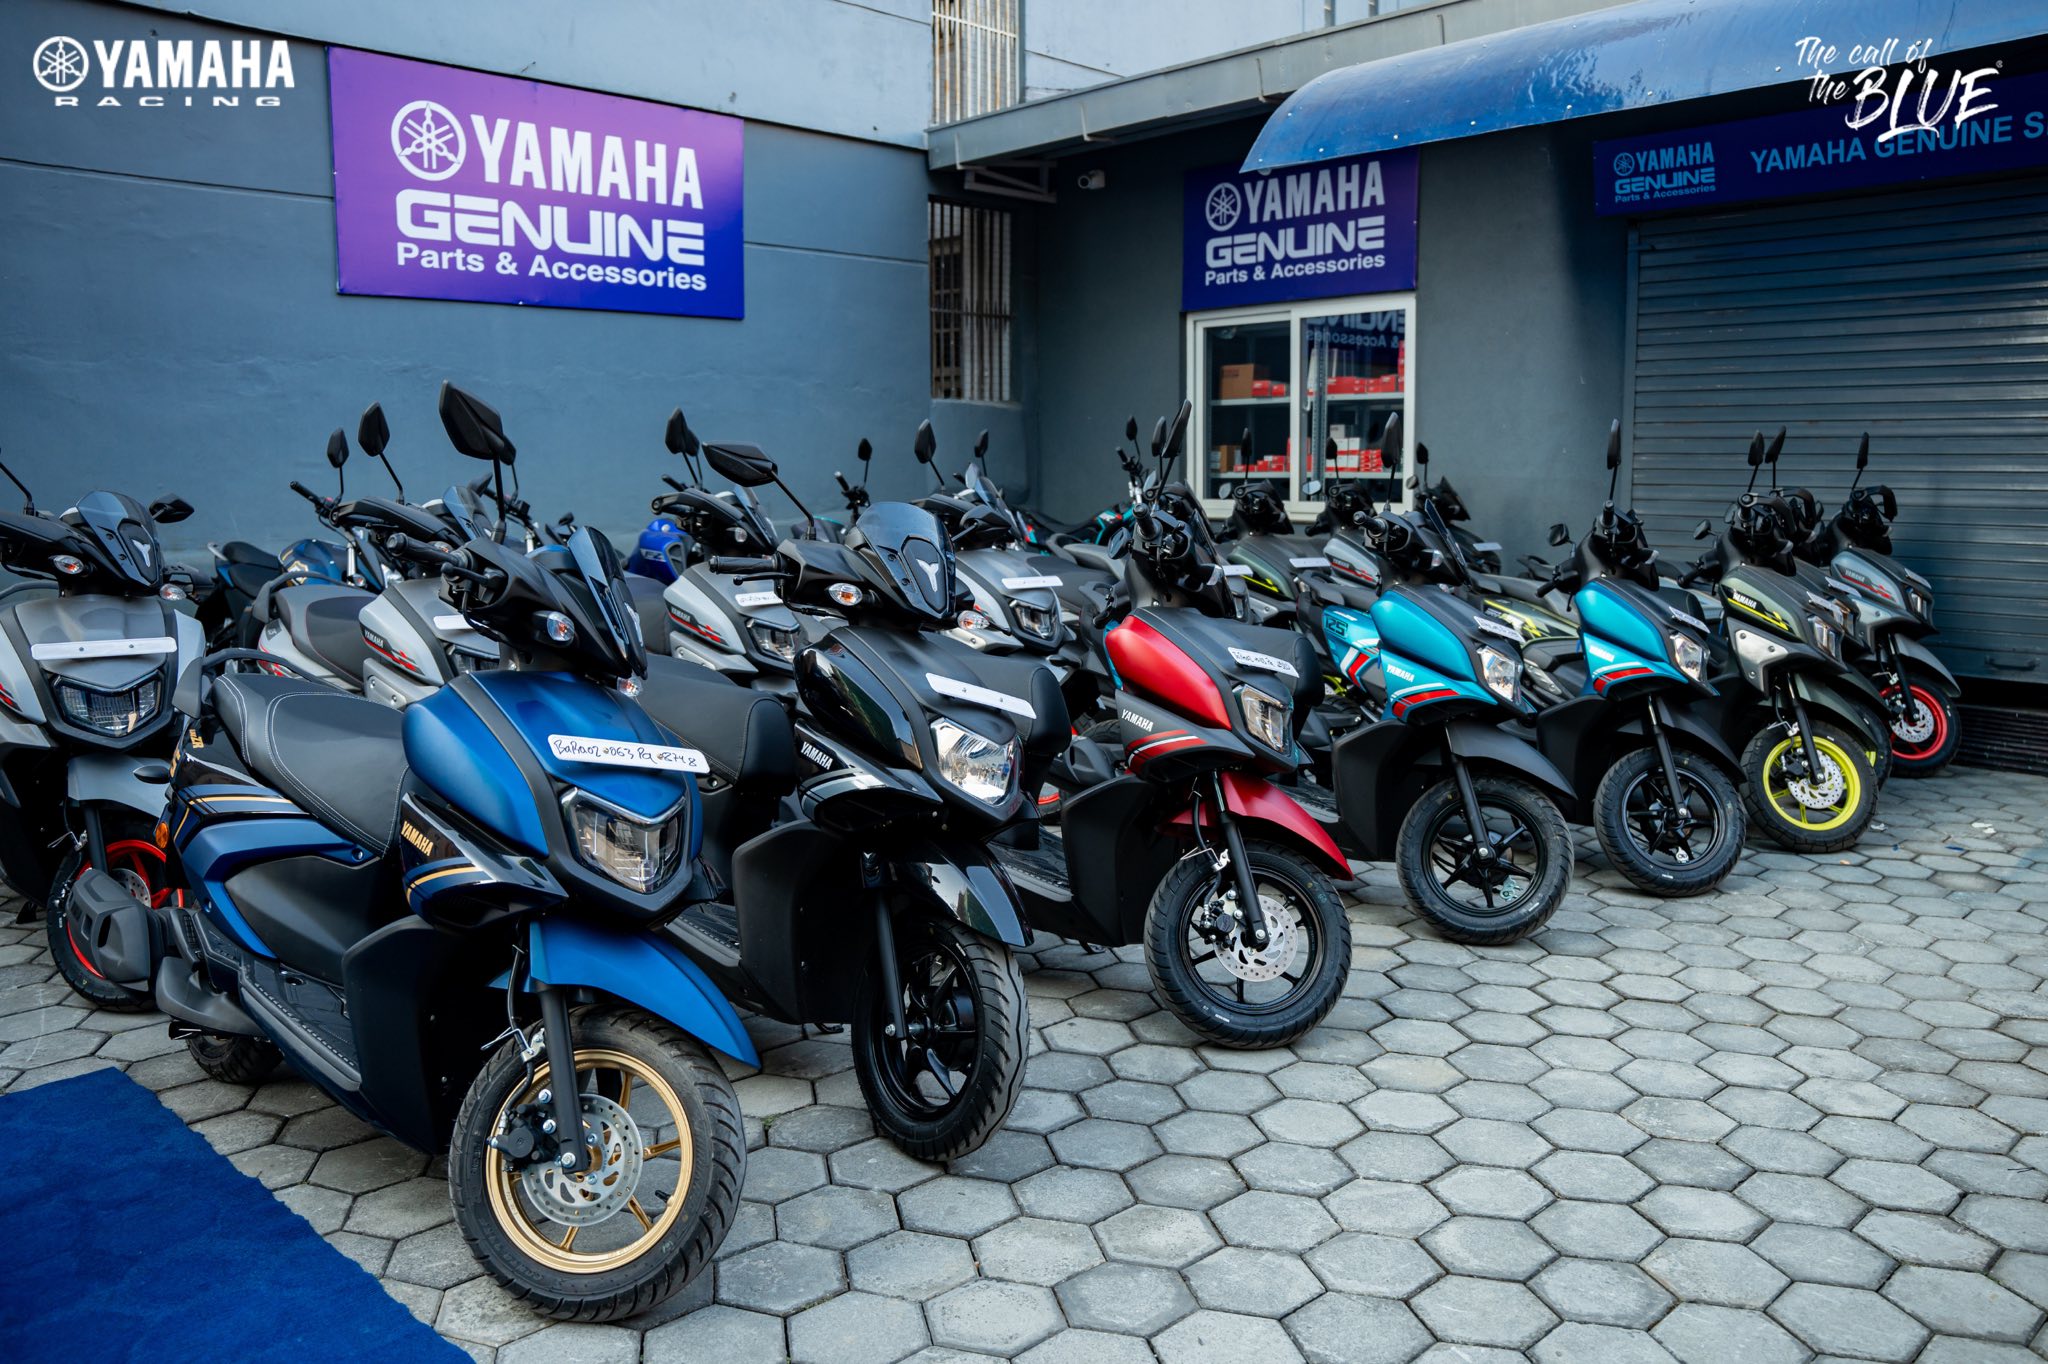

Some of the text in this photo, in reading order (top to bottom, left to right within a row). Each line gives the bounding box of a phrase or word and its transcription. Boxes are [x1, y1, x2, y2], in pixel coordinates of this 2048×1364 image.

[1636, 141, 1715, 172] YAMAHA
[1750, 111, 2048, 174] YAMAHA GENUINE S
[470, 114, 704, 209] YAMAHA
[1243, 161, 1386, 224] YAMAHA
[1615, 167, 1716, 195] GENUINE
[1615, 185, 1717, 203] Parts & Accessories
[396, 188, 705, 266] GENUINE
[1205, 215, 1386, 269] GENUINE
[397, 242, 707, 291] Parts & Accessories
[1205, 253, 1386, 287] Parts & Accessories
[1732, 589, 1757, 609] YAMAHA
[1386, 664, 1415, 683] YAMAHA
[1121, 709, 1154, 732] YAMAHA
[800, 741, 833, 770] YAMAHA
[401, 820, 434, 856] YAMAHA
